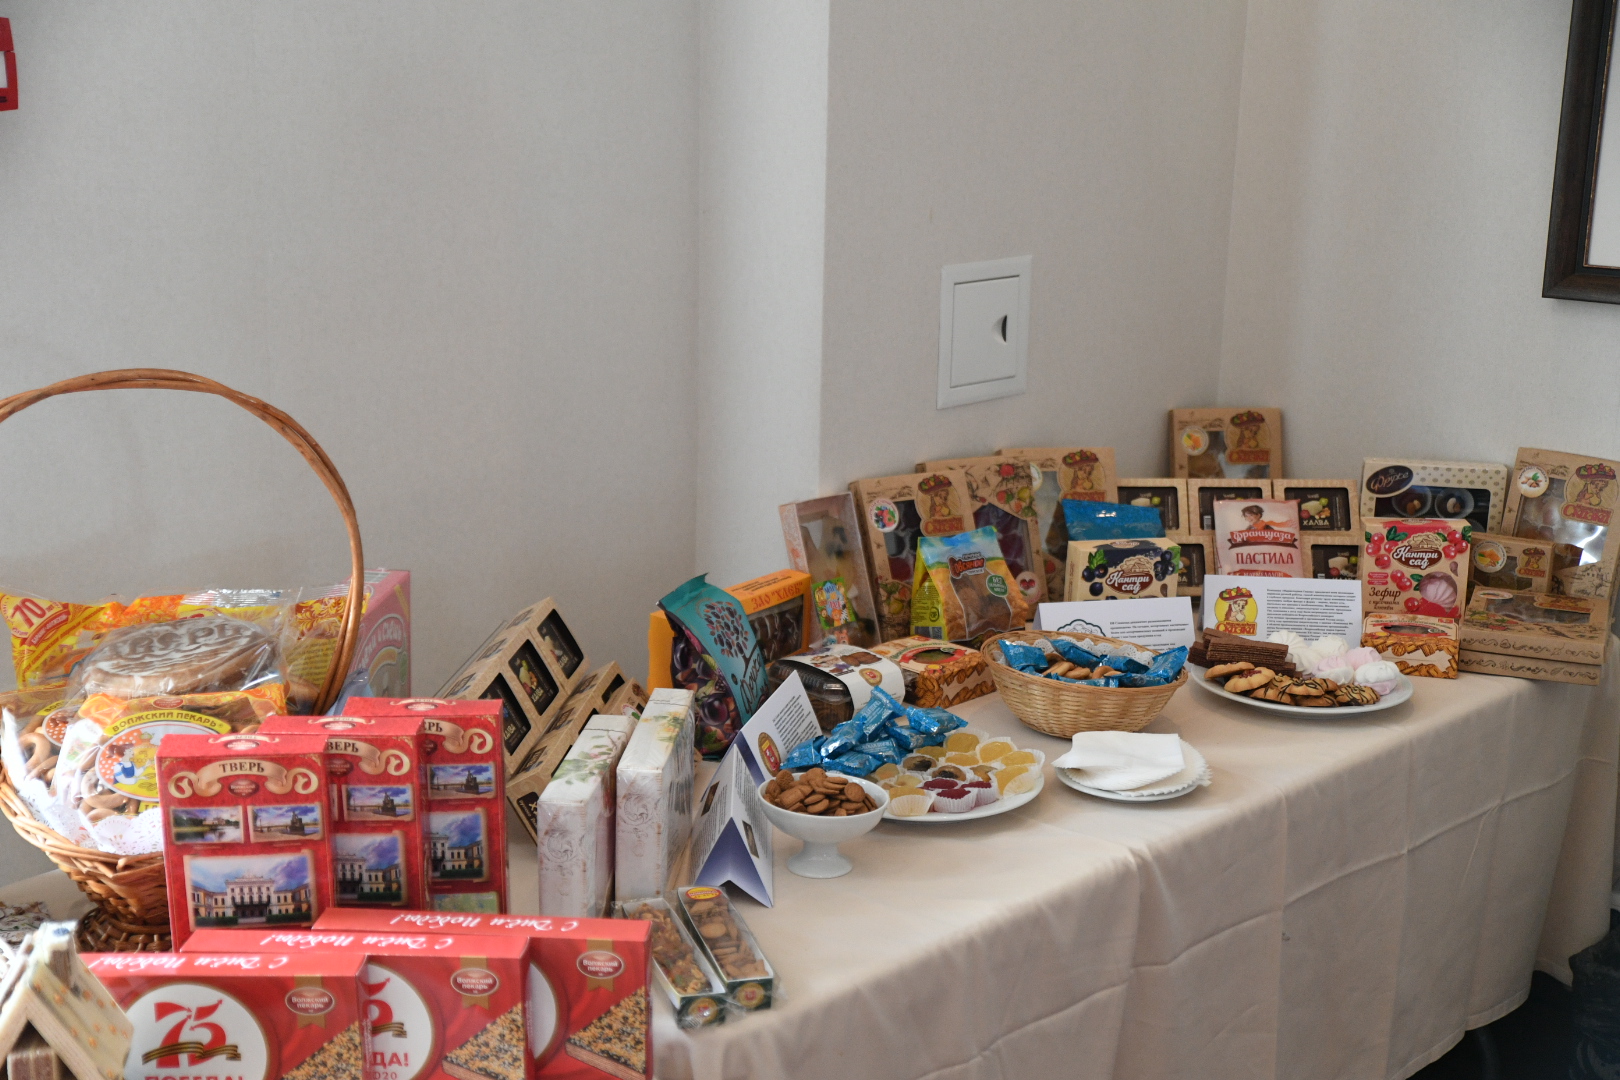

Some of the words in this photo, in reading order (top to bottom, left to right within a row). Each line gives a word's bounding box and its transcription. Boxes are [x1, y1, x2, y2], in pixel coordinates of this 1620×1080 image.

[1233, 531, 1292, 542] Француаза
[1236, 552, 1294, 564] ПАСТИЛА
[1393, 546, 1438, 562] Кантри
[1409, 558, 1429, 569] сад
[1107, 571, 1150, 587] Кантри
[1122, 583, 1141, 594] сад
[1369, 587, 1401, 601] Зефир
[11, 598, 46, 629] 70
[112, 711, 174, 732] ВОЛЖСКИЙ
[177, 712, 217, 728] ПЕКАРЬ
[327, 741, 359, 752] ВЕРЬ
[219, 762, 265, 773] ТВЕРЬ
[560, 921, 580, 932] С
[434, 938, 454, 950] С
[268, 956, 289, 969] С
[154, 998, 227, 1069] 75
